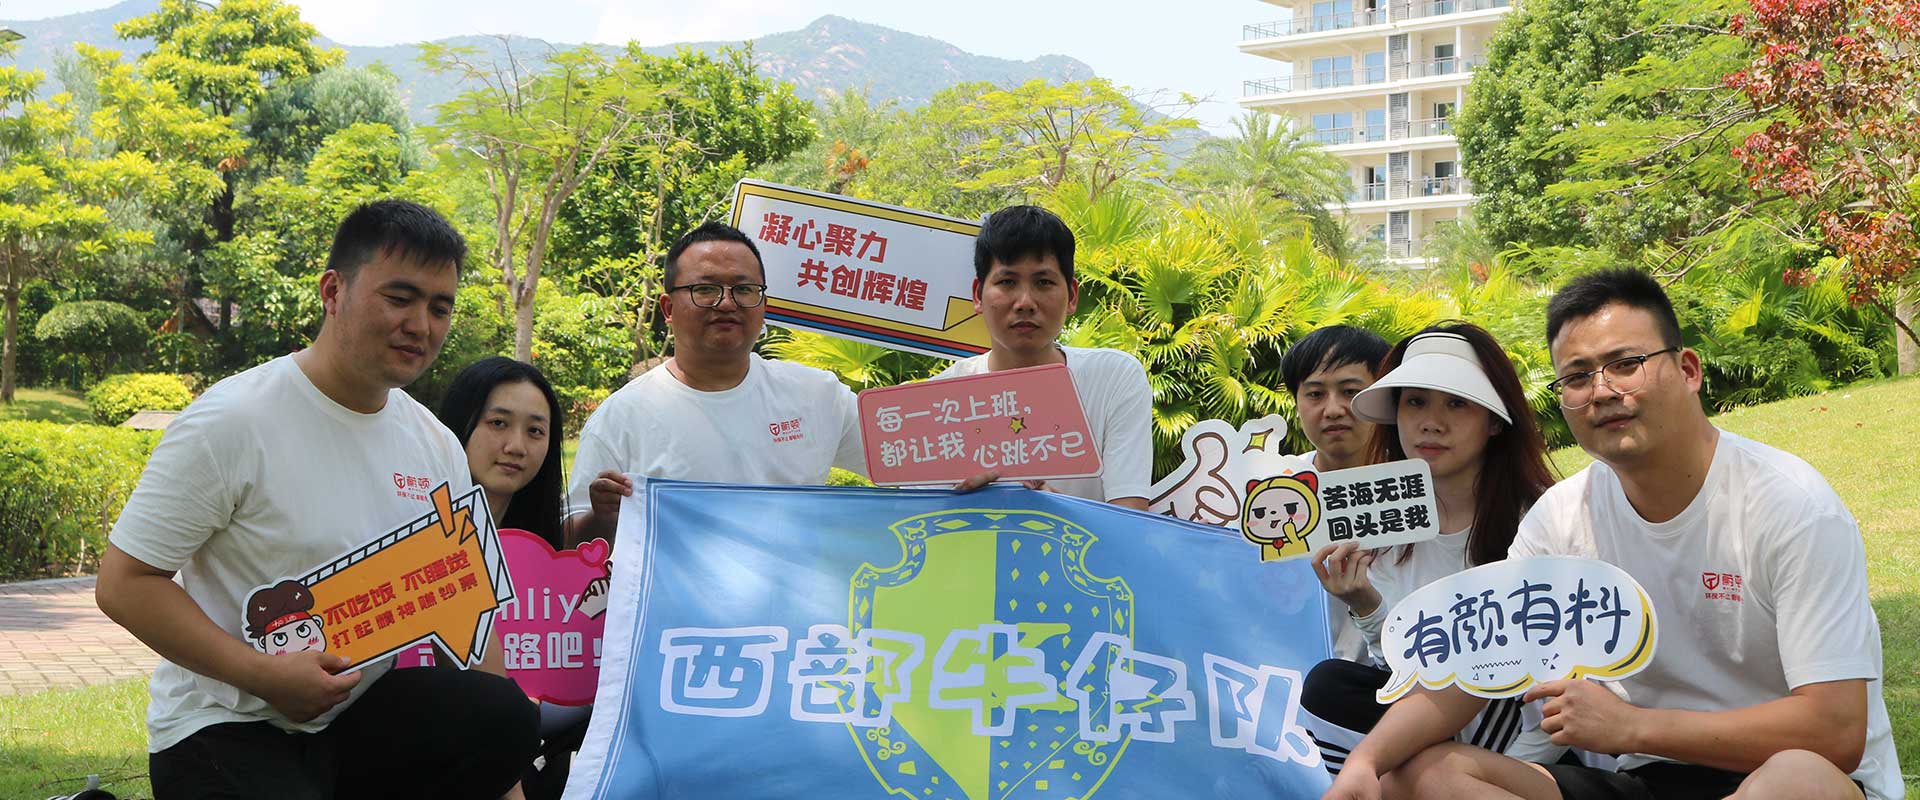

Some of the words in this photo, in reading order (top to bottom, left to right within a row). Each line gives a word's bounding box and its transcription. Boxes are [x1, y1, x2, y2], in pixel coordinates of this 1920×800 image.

[758, 212, 888, 264] 凝心聚力
[797, 258, 928, 312] 共创辉煌
[1323, 473, 1427, 511] 苦海无涯
[1327, 504, 1431, 542] 回头是我
[323, 580, 397, 626] 不吃饭
[401, 549, 471, 592] 不睡觉
[1403, 578, 1631, 668] 有颜有料
[660, 624, 1322, 767] 西部牛仔队
